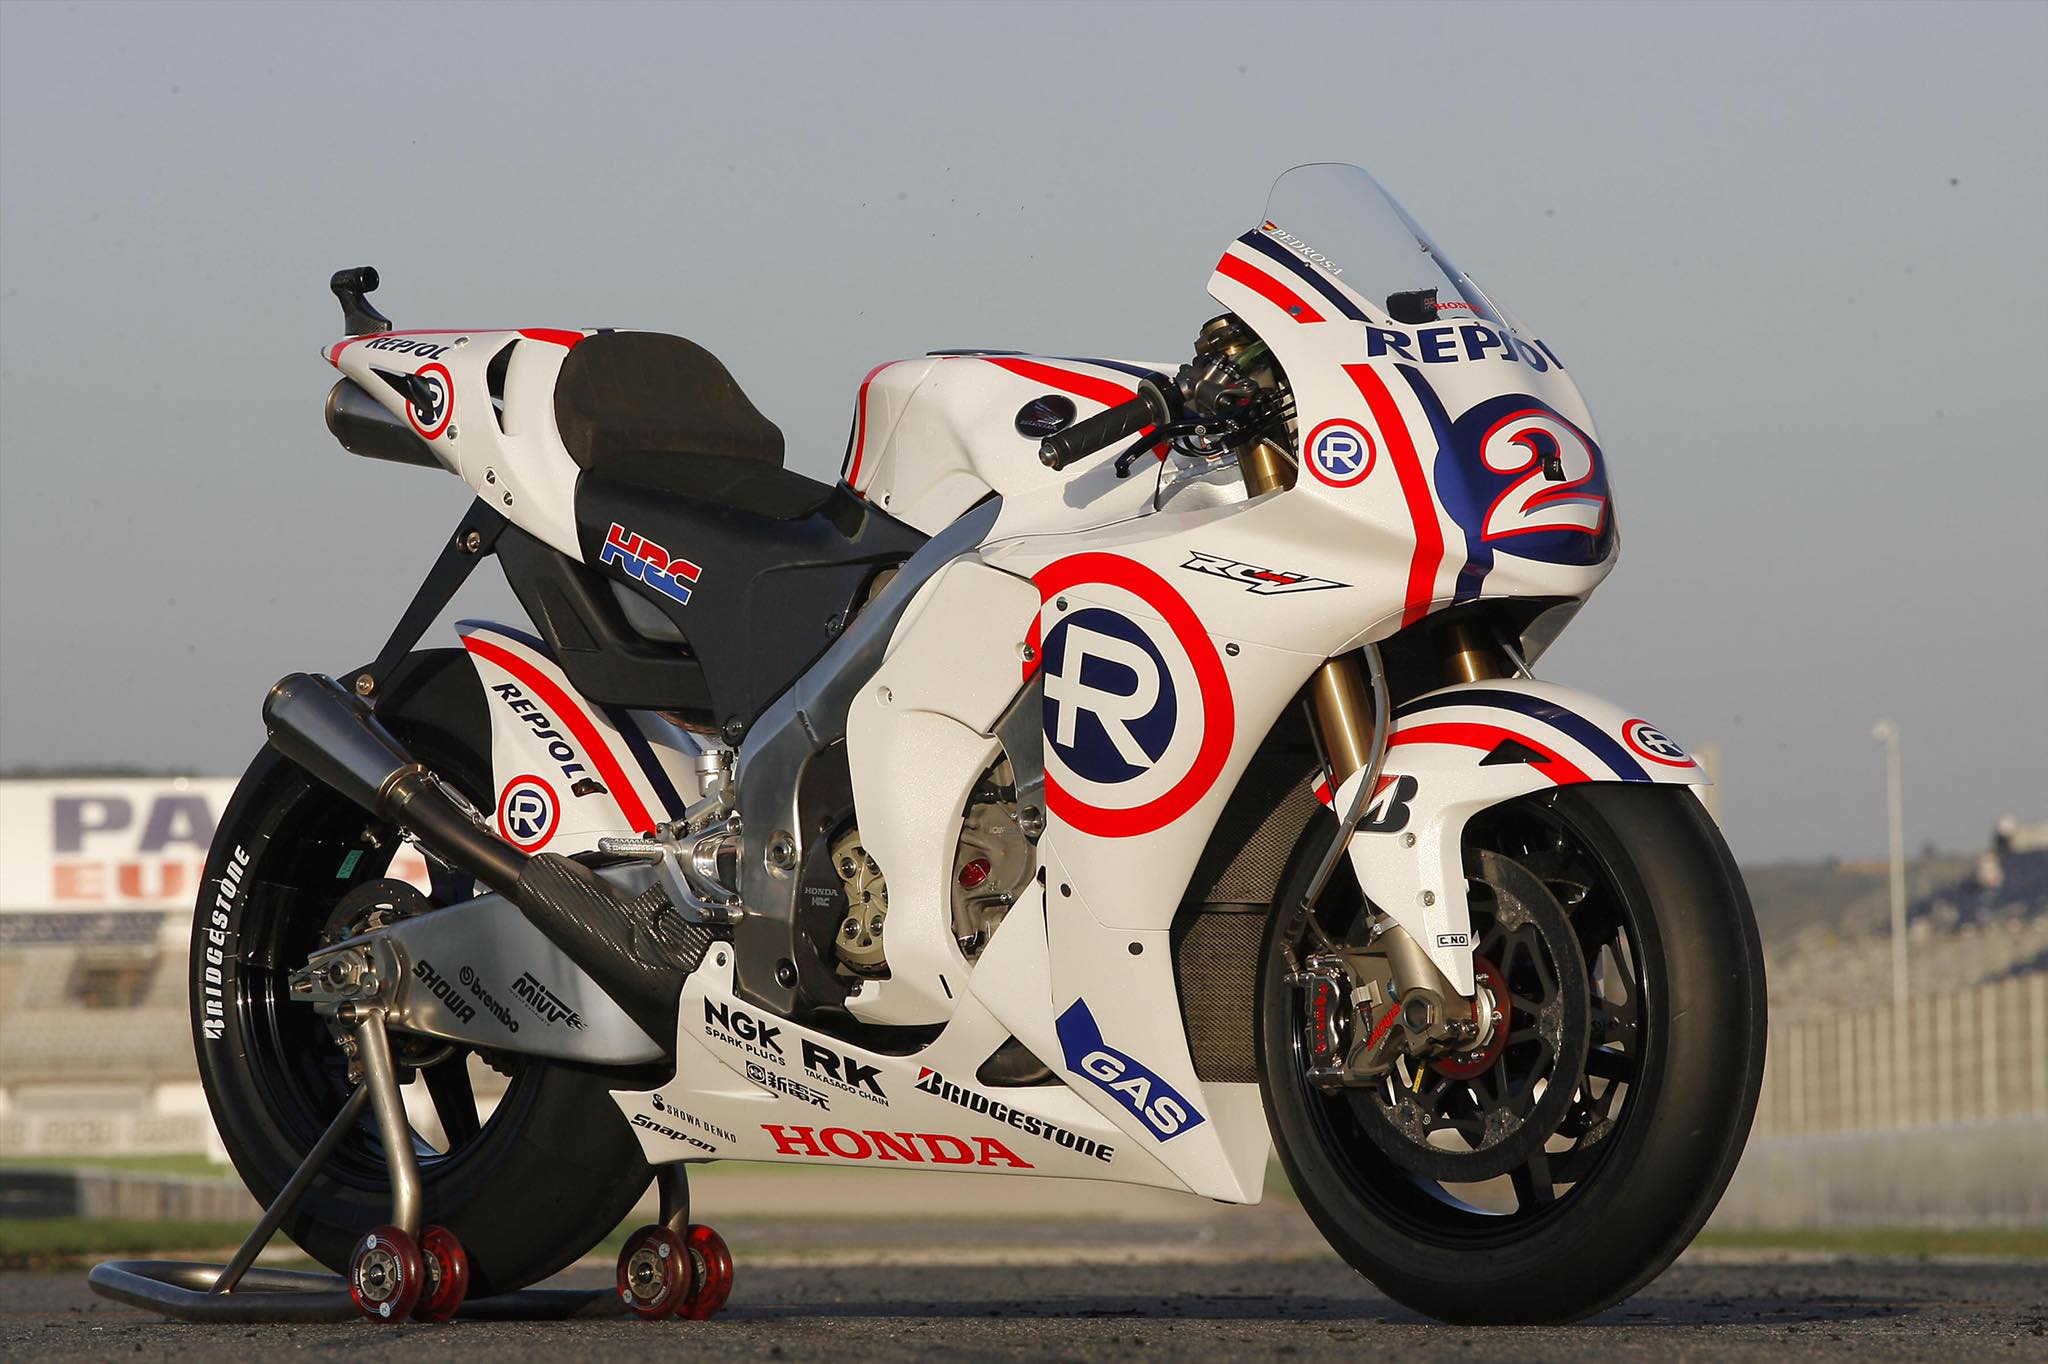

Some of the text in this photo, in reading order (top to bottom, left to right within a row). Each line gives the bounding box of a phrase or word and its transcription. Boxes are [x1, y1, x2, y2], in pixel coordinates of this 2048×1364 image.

[1270, 229, 1344, 275] PEDROSA
[365, 337, 451, 361] REPSOL
[1479, 407, 1607, 542] 2
[491, 683, 586, 780] REPSOL
[804, 886, 840, 897] HONDA
[203, 844, 251, 1040] BRIDGESTONE
[412, 959, 476, 1025] SHOWA
[469, 976, 520, 1034] brembo
[704, 994, 784, 1055] NGK
[705, 1025, 786, 1067] SPARK PLUGS
[801, 1038, 888, 1099] RK
[804, 1068, 890, 1108] TAKASAGO CHAIN
[1080, 1051, 1187, 1136] GAS
[630, 1113, 717, 1153] Snap-on
[666, 1104, 737, 1144] SHOWA DENKO
[915, 1066, 1116, 1163] BRIDGESTONE
[760, 1124, 1036, 1169] HONDA
